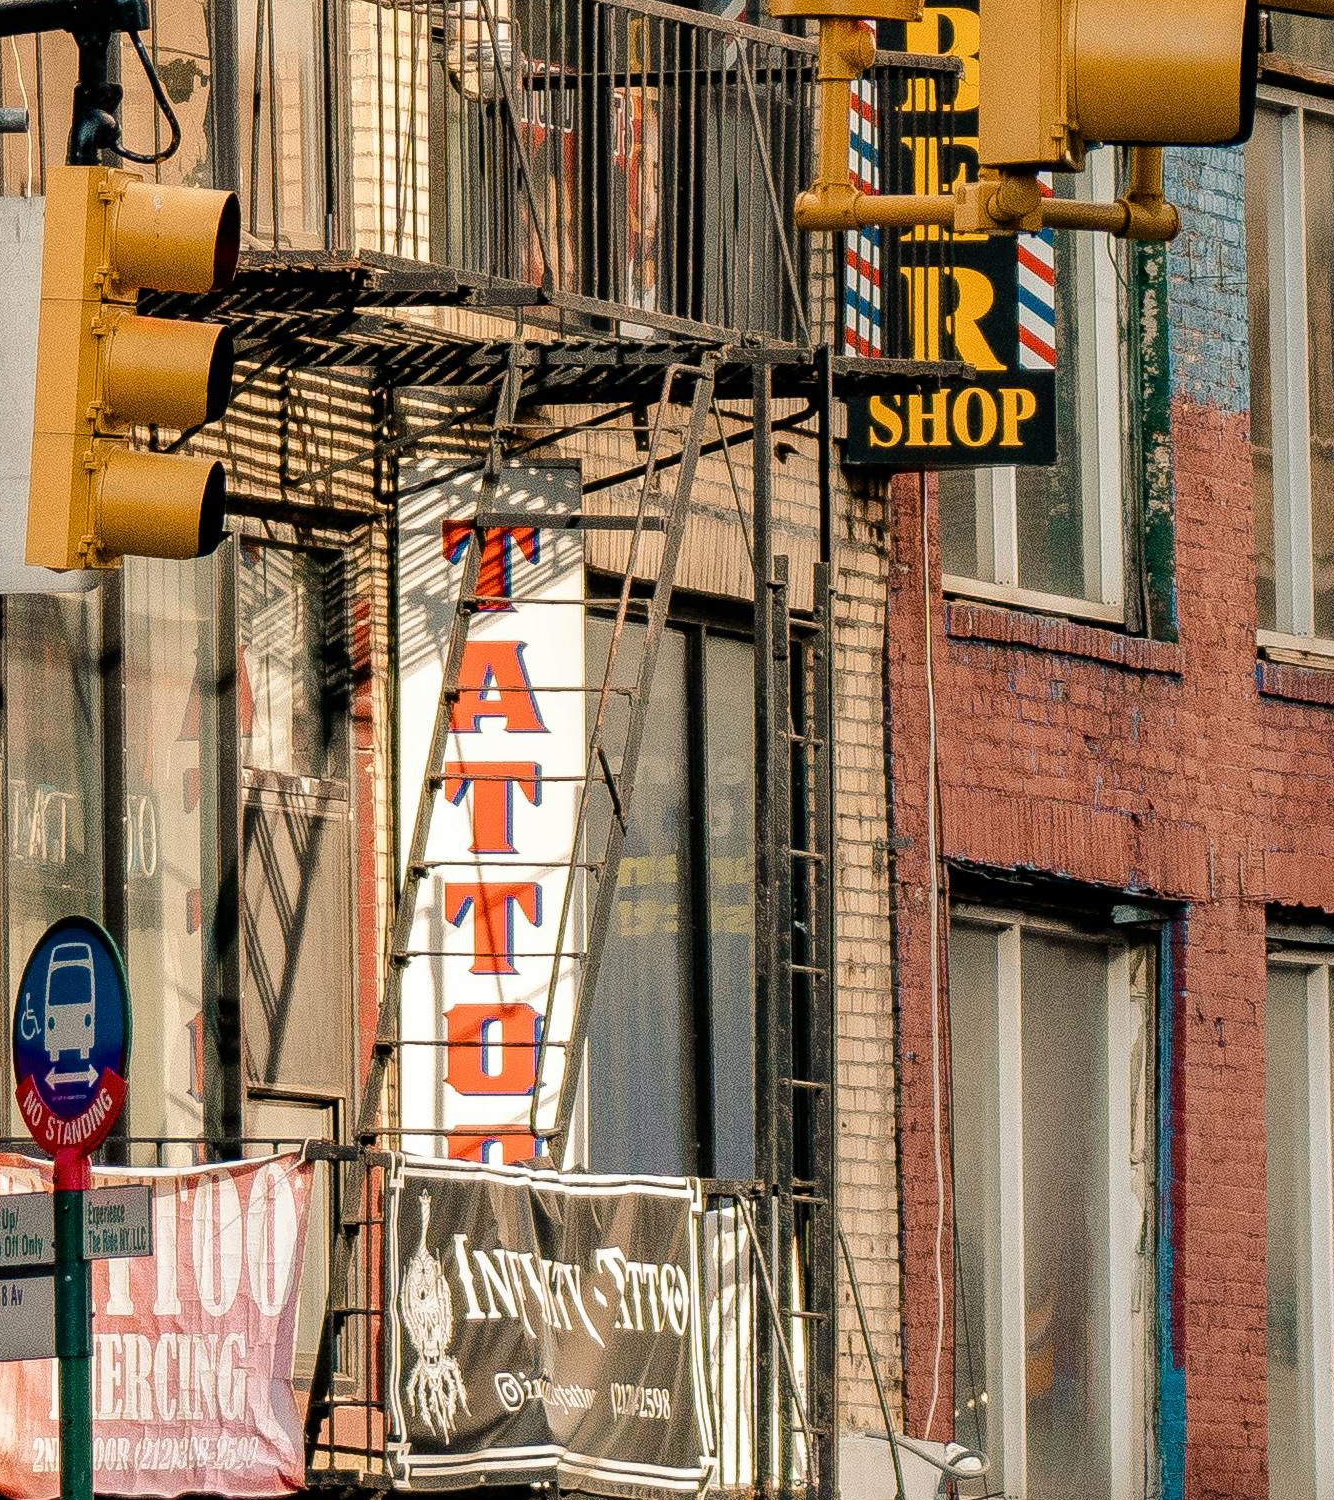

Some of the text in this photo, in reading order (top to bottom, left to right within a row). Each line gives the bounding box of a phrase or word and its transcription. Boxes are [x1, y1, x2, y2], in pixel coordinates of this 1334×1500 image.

[868, 386, 1037, 450] SHOP
[23, 1087, 113, 1145] NO STANDING
[21, 1233, 44, 1260] Only
[0, 1285, 8, 1308] 8
[10, 1284, 24, 1307] Av
